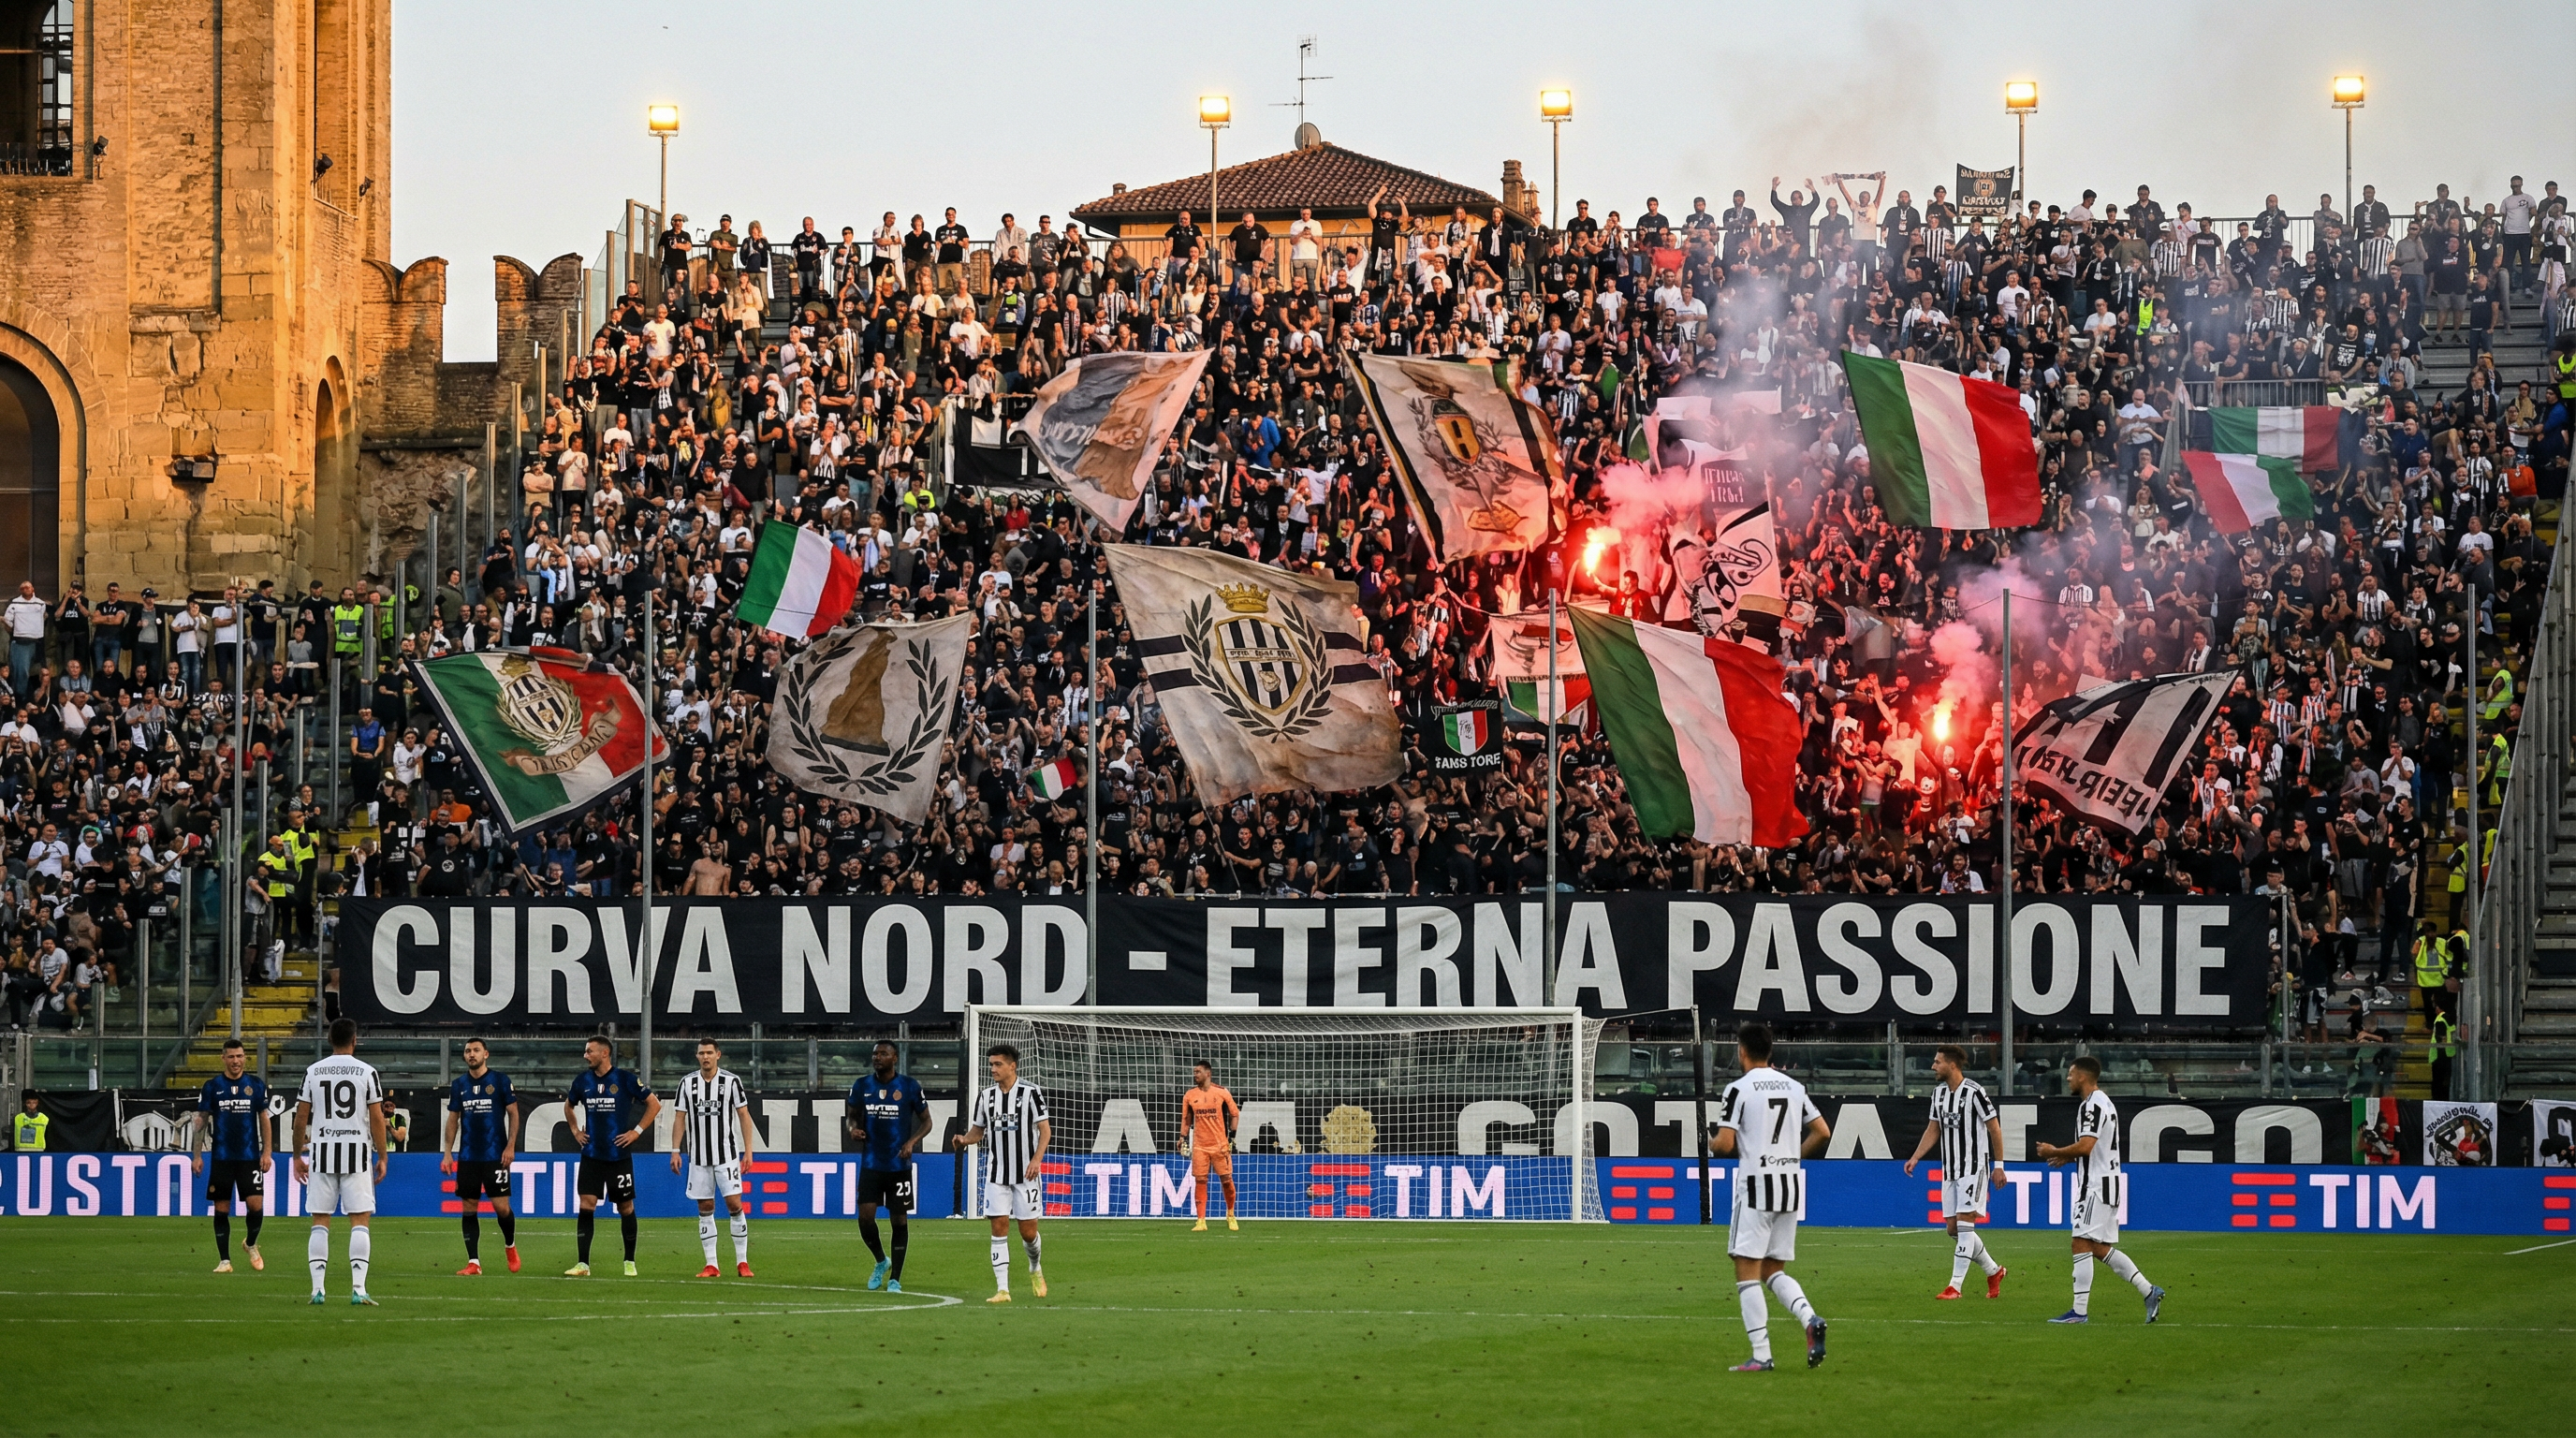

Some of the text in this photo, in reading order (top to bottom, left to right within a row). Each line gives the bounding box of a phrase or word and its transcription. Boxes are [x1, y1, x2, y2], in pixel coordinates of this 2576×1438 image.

[372, 903, 743, 1016] CURVA
[782, 902, 1087, 1015] NORD
[1206, 901, 1628, 1010] ETERNA
[1667, 900, 2232, 1016] PASSIONE
[319, 1079, 357, 1120] 19
[1767, 1097, 1789, 1145] 7
[1026, 1188, 1038, 1204] 12
[1383, 1165, 1506, 1217] TIM
[2309, 1173, 2437, 1229] TIM
